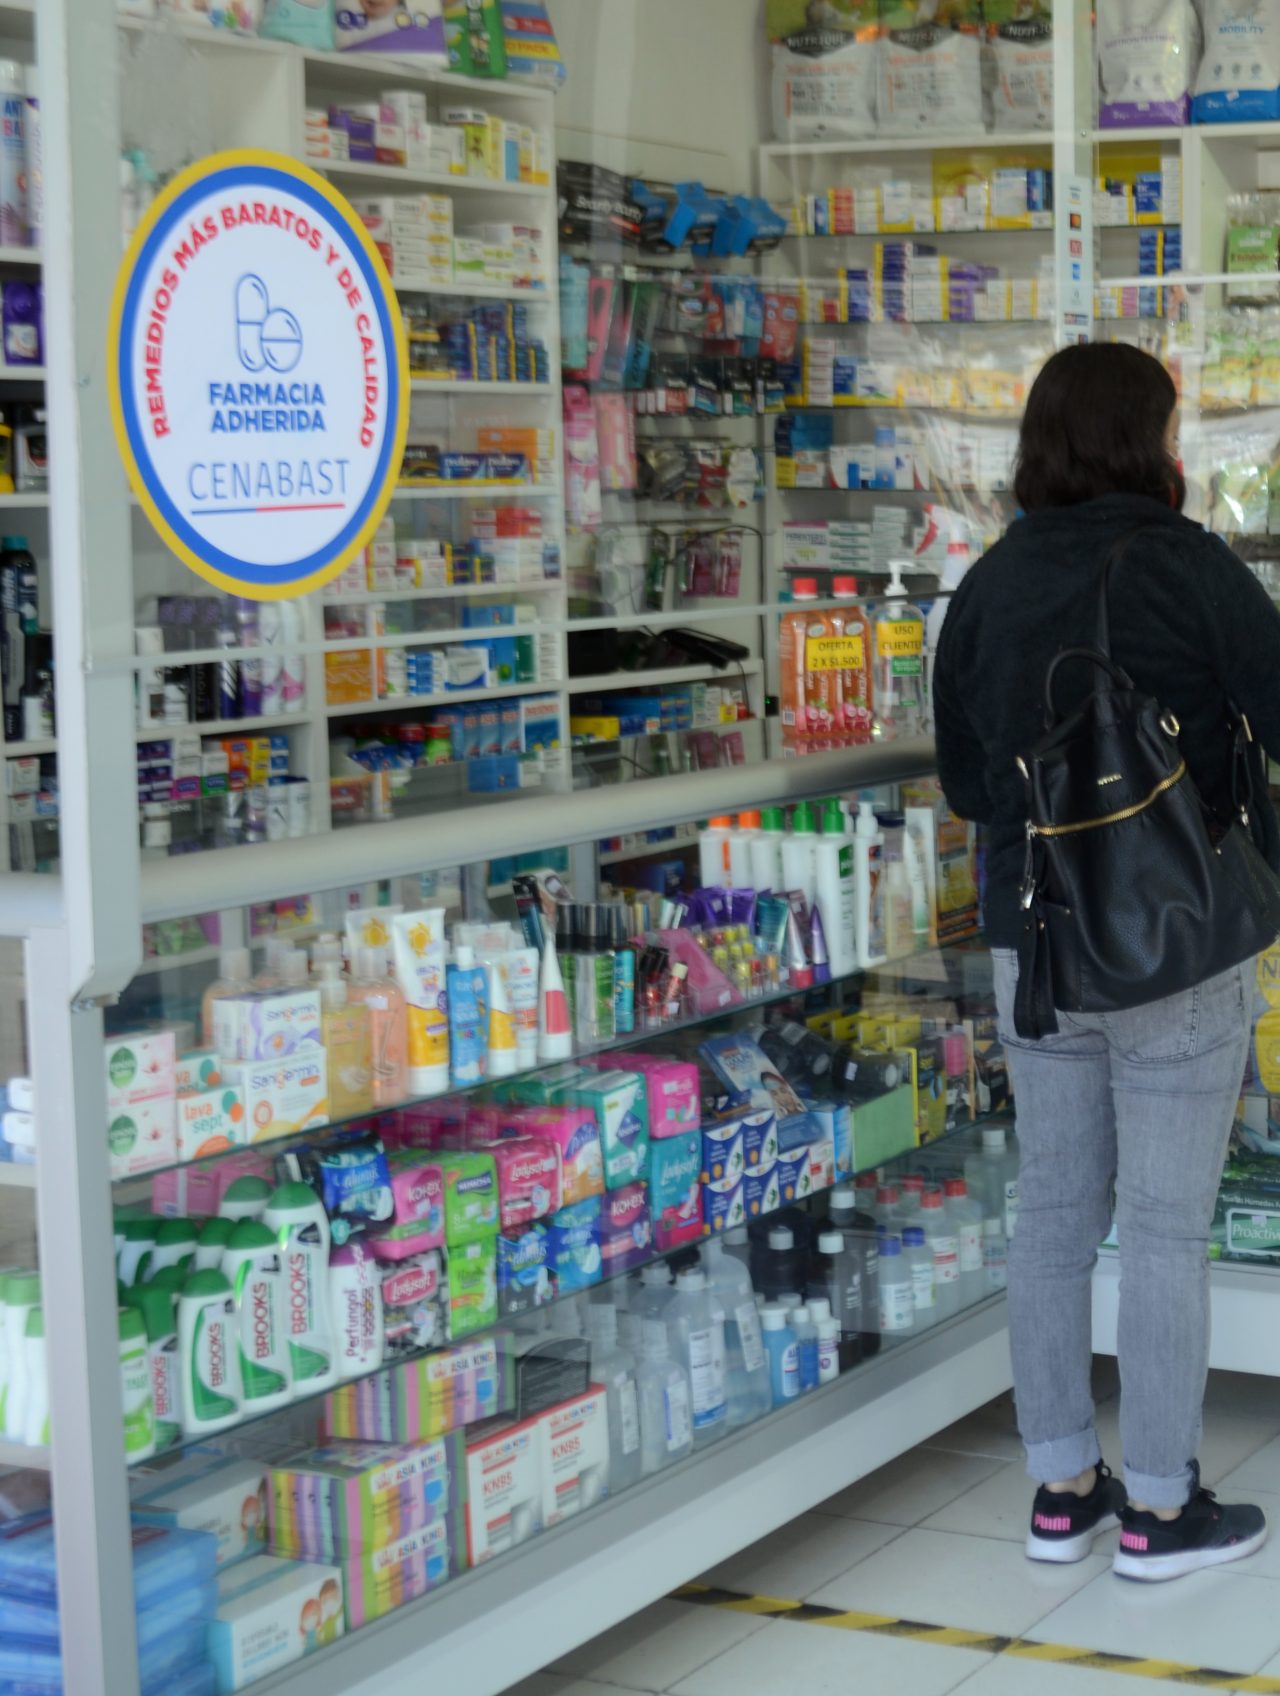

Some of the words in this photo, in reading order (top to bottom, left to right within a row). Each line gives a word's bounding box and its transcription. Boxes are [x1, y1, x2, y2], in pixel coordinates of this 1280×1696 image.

[144, 268, 180, 439] REMEDIOS
[173, 215, 220, 270] MÁS
[221, 202, 322, 252] BARATOS
[324, 243, 342, 265] Y
[336, 267, 361, 309] DE
[356, 314, 381, 449] CALIDAD
[209, 383, 326, 406] FARMACIA
[210, 409, 327, 433] ADHERIDA
[188, 459, 350, 500] CENABAST
[893, 625, 915, 635] USO
[818, 641, 854, 651] OFERTA
[812, 658, 818, 667] 2
[820, 657, 827, 667] X
[184, 1102, 213, 1121] lava
[191, 1113, 223, 1139] sept
[290, 1252, 307, 1335] BROOKS
[253, 1281, 270, 1360] BROOKS
[208, 1322, 222, 1387] BROOKS
[473, 1350, 494, 1366] KING
[152, 1355, 167, 1416] BROOKS
[396, 1463, 416, 1480] ASIA
[420, 1449, 442, 1468] KING
[1034, 1512, 1071, 1531] PUMA
[421, 1524, 443, 1544] KING
[1119, 1531, 1149, 1552] UMA
